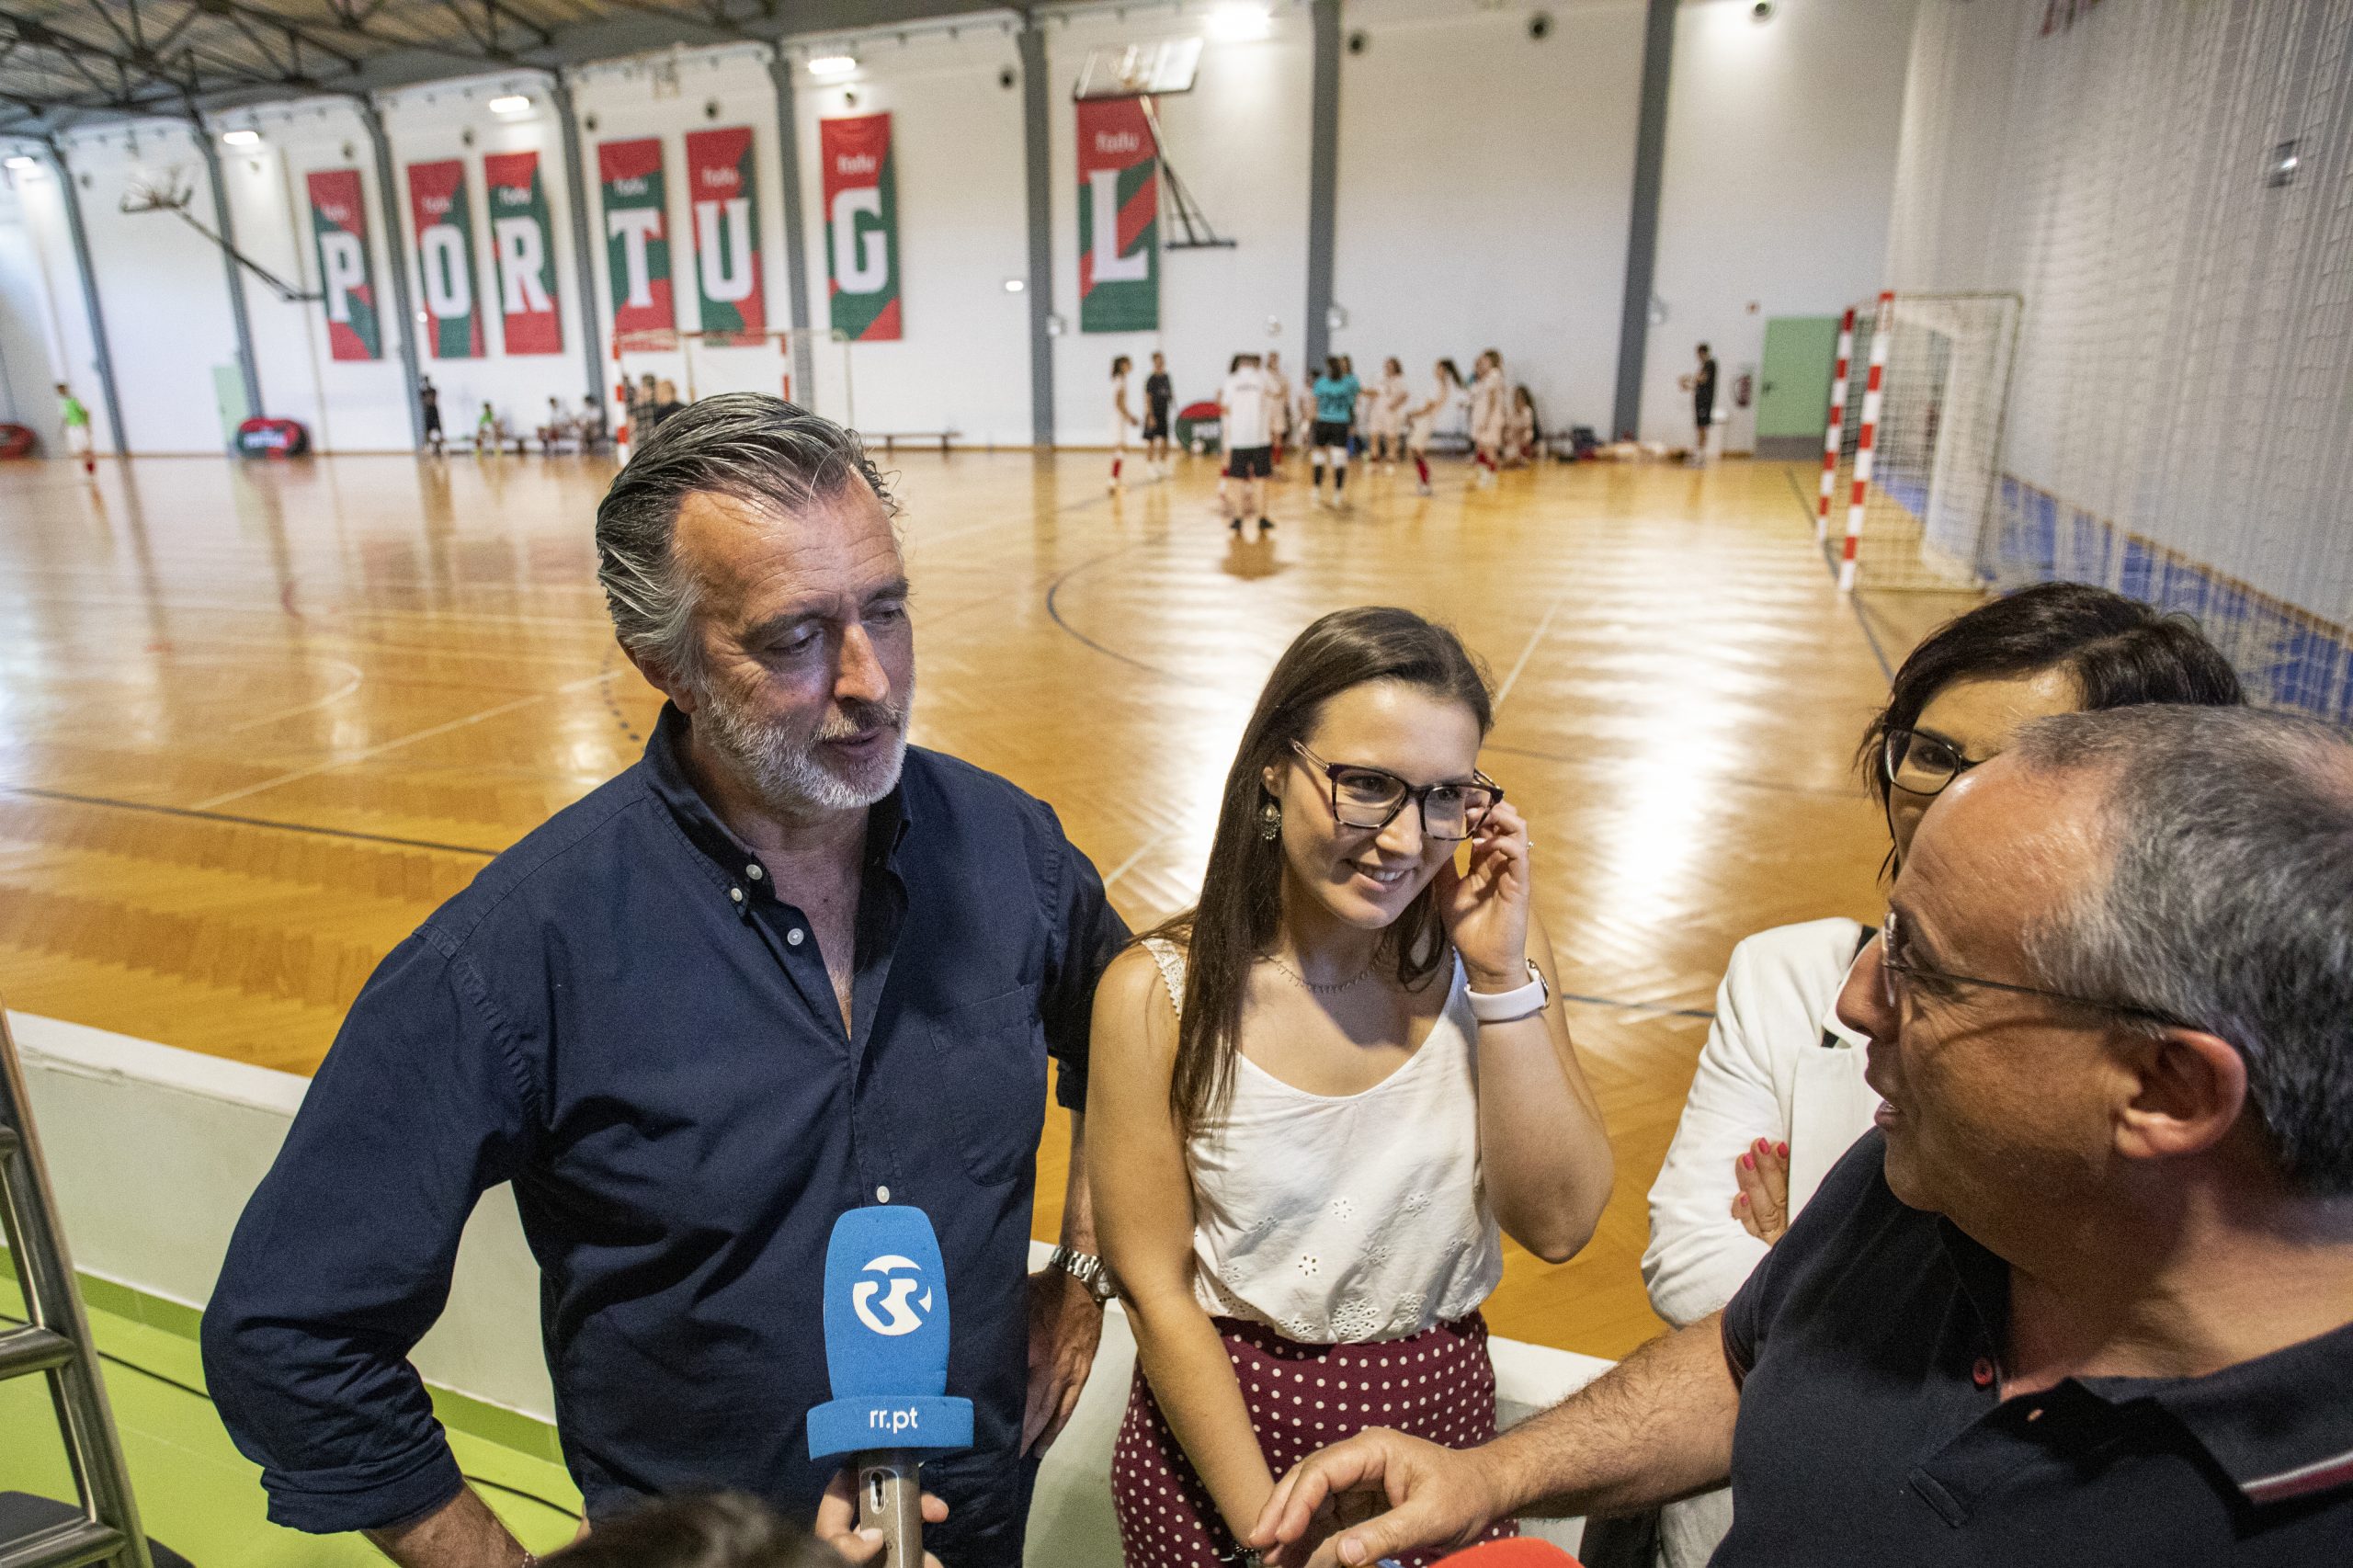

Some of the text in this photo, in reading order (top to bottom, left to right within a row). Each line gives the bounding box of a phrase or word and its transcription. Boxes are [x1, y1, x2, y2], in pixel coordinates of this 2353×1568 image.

[419, 226, 472, 319] O
[494, 216, 552, 313] R
[608, 207, 663, 309] T
[696, 198, 754, 302] U
[833, 187, 889, 295] G
[1089, 169, 1148, 282] L
[322, 232, 366, 322] P
[869, 1407, 919, 1434] rr.pt
